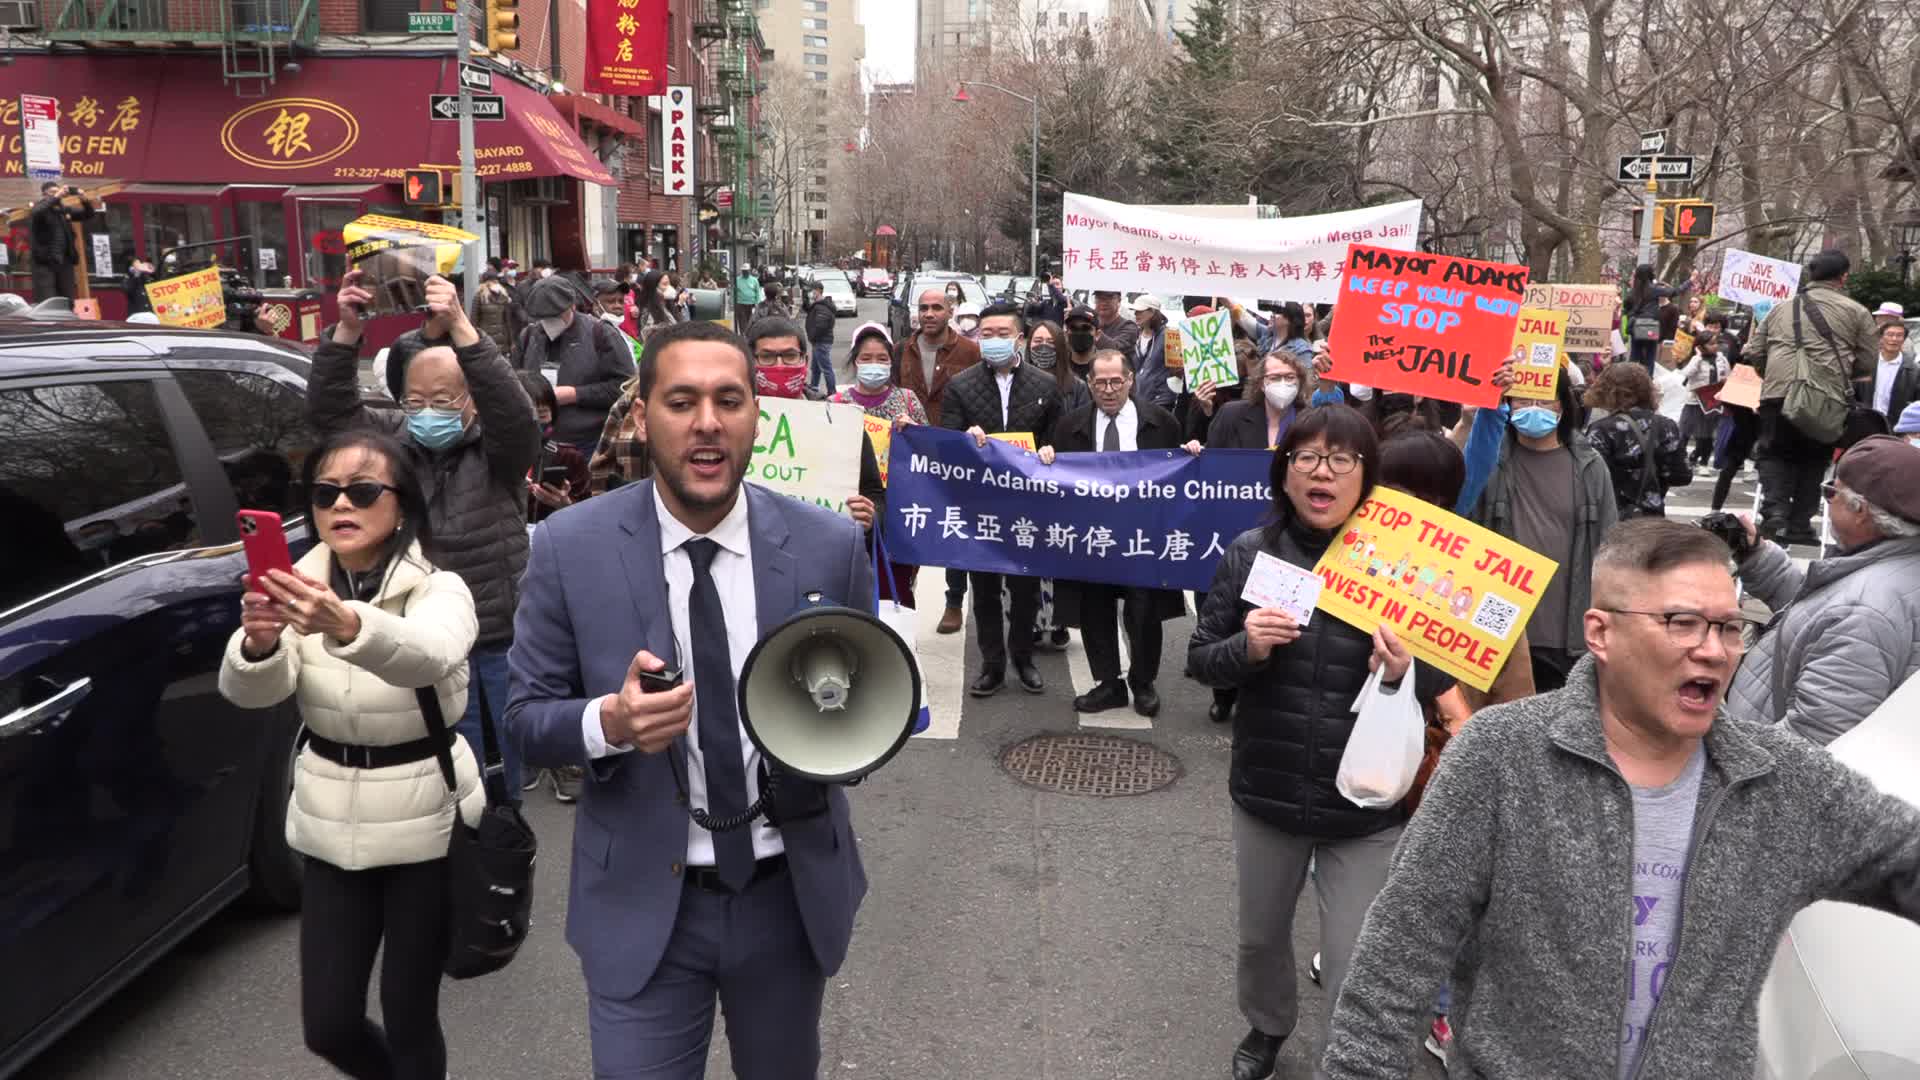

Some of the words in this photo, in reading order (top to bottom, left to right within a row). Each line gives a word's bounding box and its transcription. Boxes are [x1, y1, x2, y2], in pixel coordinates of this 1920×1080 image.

[410, 15, 443, 25] BAYARD
[473, 103, 495, 113] WAY
[263, 108, 312, 158] 銀
[671, 110, 685, 174] PARK
[86, 136, 127, 155] FEN
[475, 146, 524, 159] BAYARD
[70, 160, 104, 175] Roll
[334, 168, 406, 178] 212-227-488
[1631, 163, 1650, 173] ONE
[1661, 163, 1683, 172] WAY
[1066, 214, 1107, 230] Mayor
[1112, 221, 1164, 240] Adams,
[1327, 229, 1373, 243] Mega
[1443, 261, 1526, 295] ADAMS
[1748, 261, 1773, 278] SAVE
[152, 282, 180, 298] STOP
[183, 277, 201, 289] THE
[1349, 275, 1409, 297] KEEP
[1731, 273, 1790, 299] CHINATOWN
[1560, 290, 1606, 306] DON'T
[1190, 316, 1219, 338] NO
[1379, 301, 1461, 334] STOP
[1520, 319, 1560, 336] JAIL
[1183, 338, 1231, 364] MEGA
[1189, 362, 1239, 389] JAIL
[1363, 346, 1405, 363] NEW
[1397, 345, 1481, 386] JAIL
[763, 463, 807, 482] OUT
[910, 453, 975, 480] Mayor
[981, 467, 1066, 498] Adams,
[1074, 479, 1130, 503] Stop
[1137, 479, 1176, 500] the
[900, 503, 1225, 562] 市長亞當斯停止唐人
[1357, 499, 1412, 531] STOP
[1417, 519, 1471, 559] THE
[1474, 548, 1535, 596] JAIL
[1318, 564, 1383, 610] INVEST
[1380, 597, 1410, 624] IN
[1407, 610, 1500, 671] PEOPLE
